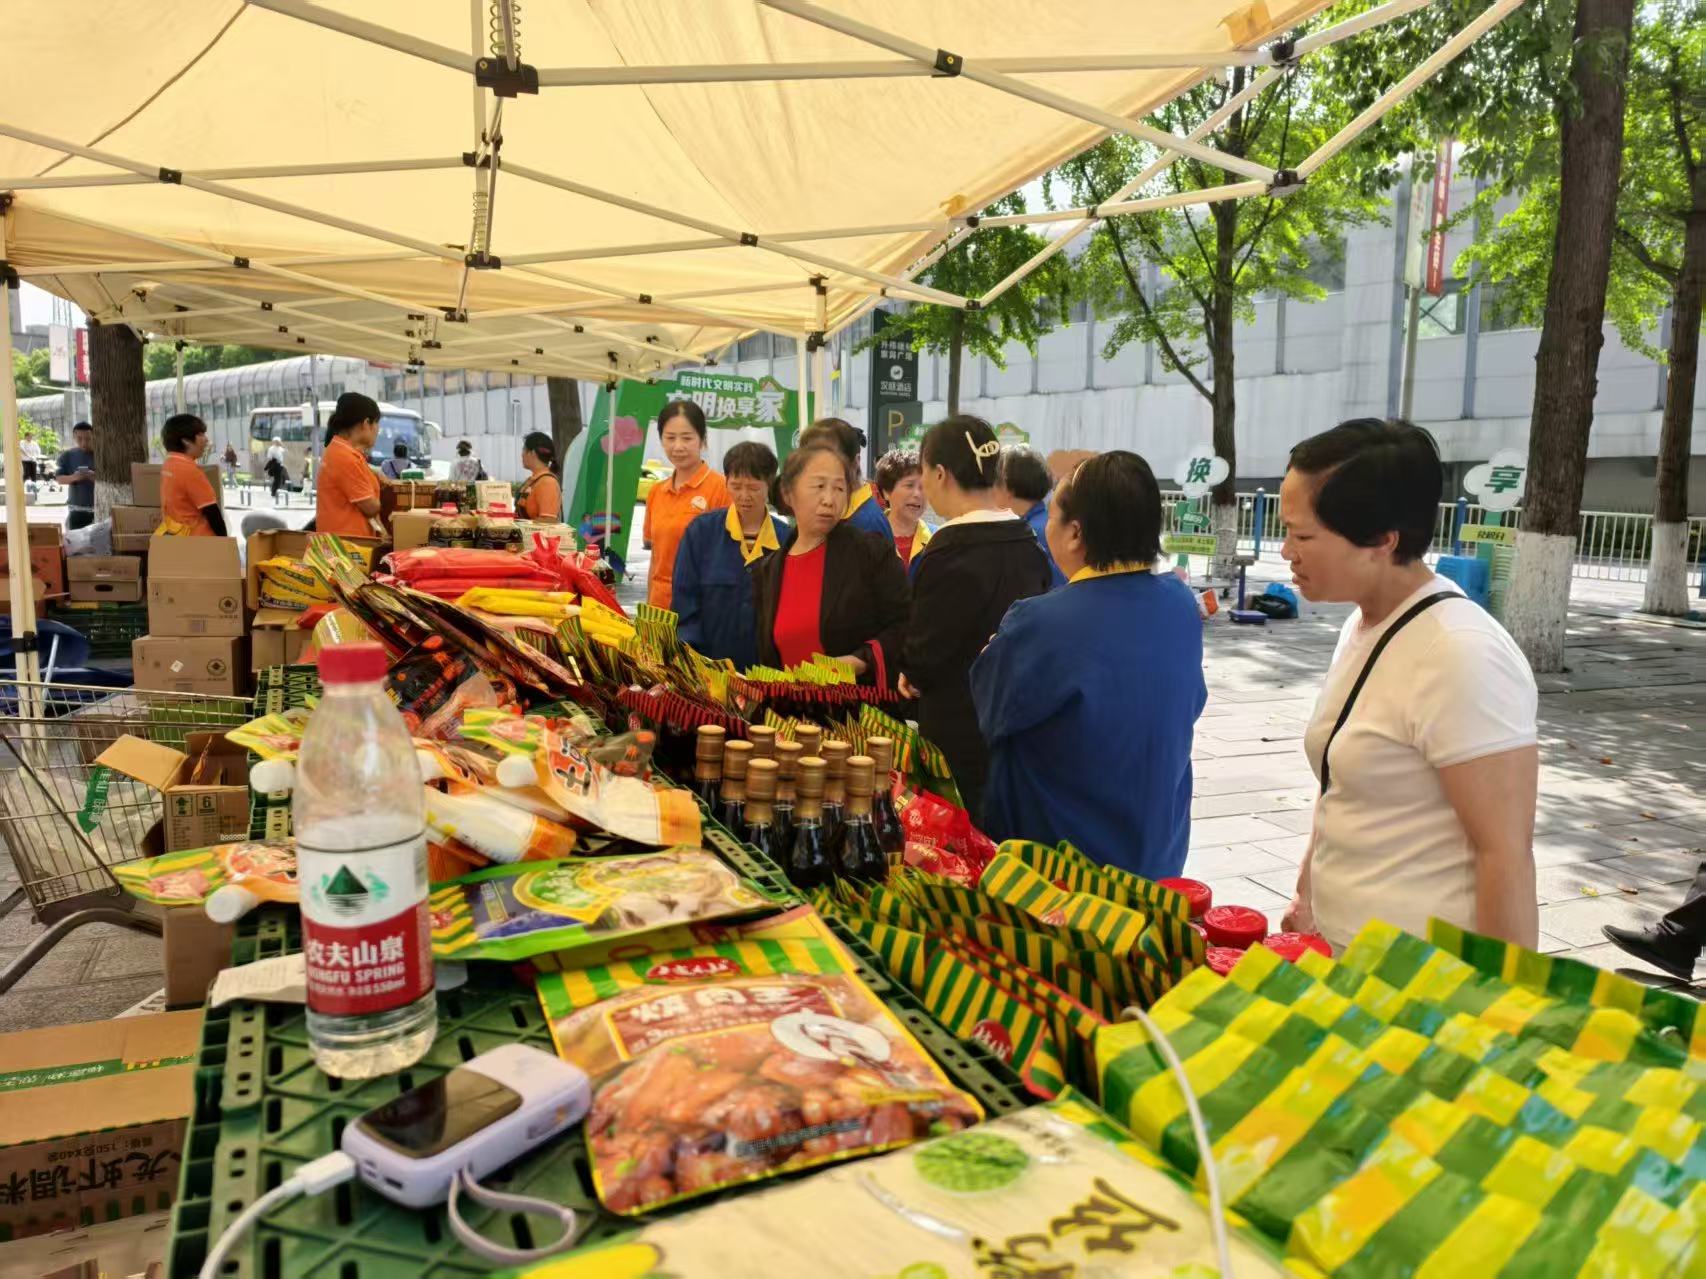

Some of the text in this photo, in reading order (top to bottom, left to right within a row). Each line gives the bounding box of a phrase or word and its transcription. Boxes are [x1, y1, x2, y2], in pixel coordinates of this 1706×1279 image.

[888, 410, 904, 436] P
[1186, 457, 1212, 483] 换
[1484, 465, 1525, 493] 享
[307, 935, 404, 968] 农夫山泉
[355, 961, 405, 983] SPRING
